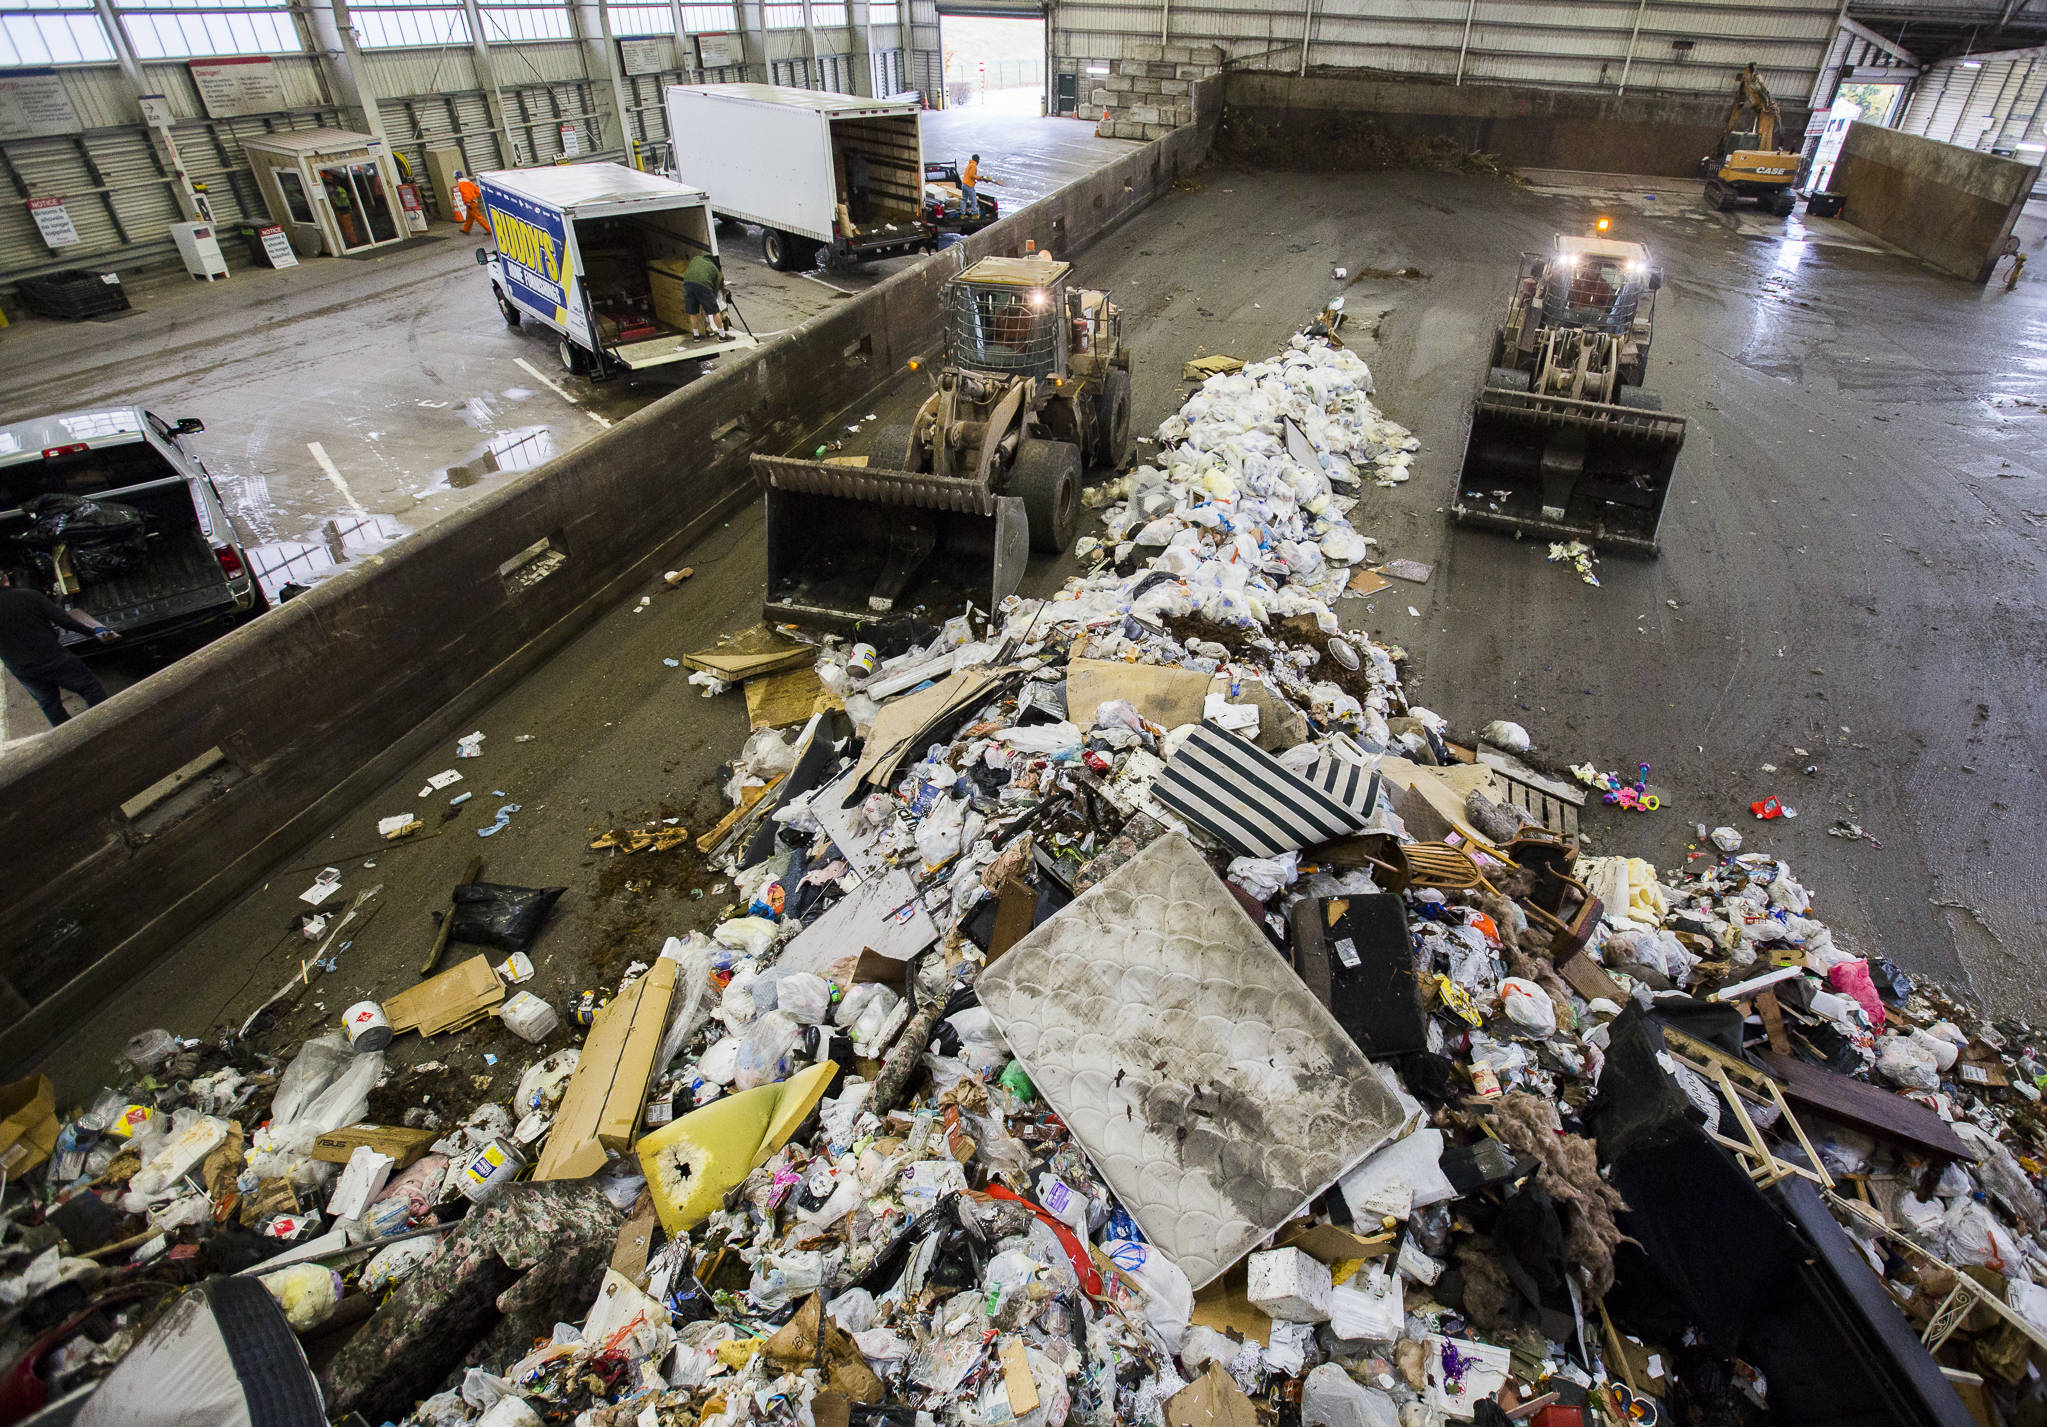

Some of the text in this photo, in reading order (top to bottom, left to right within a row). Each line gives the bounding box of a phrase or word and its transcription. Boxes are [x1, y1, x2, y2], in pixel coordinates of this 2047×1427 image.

[1756, 166, 1786, 175] CASE
[31, 199, 58, 208] NOTICE
[262, 227, 281, 235] NOTICE
[490, 208, 559, 282] BUDDY'S
[317, 1139, 346, 1148] ASUS
